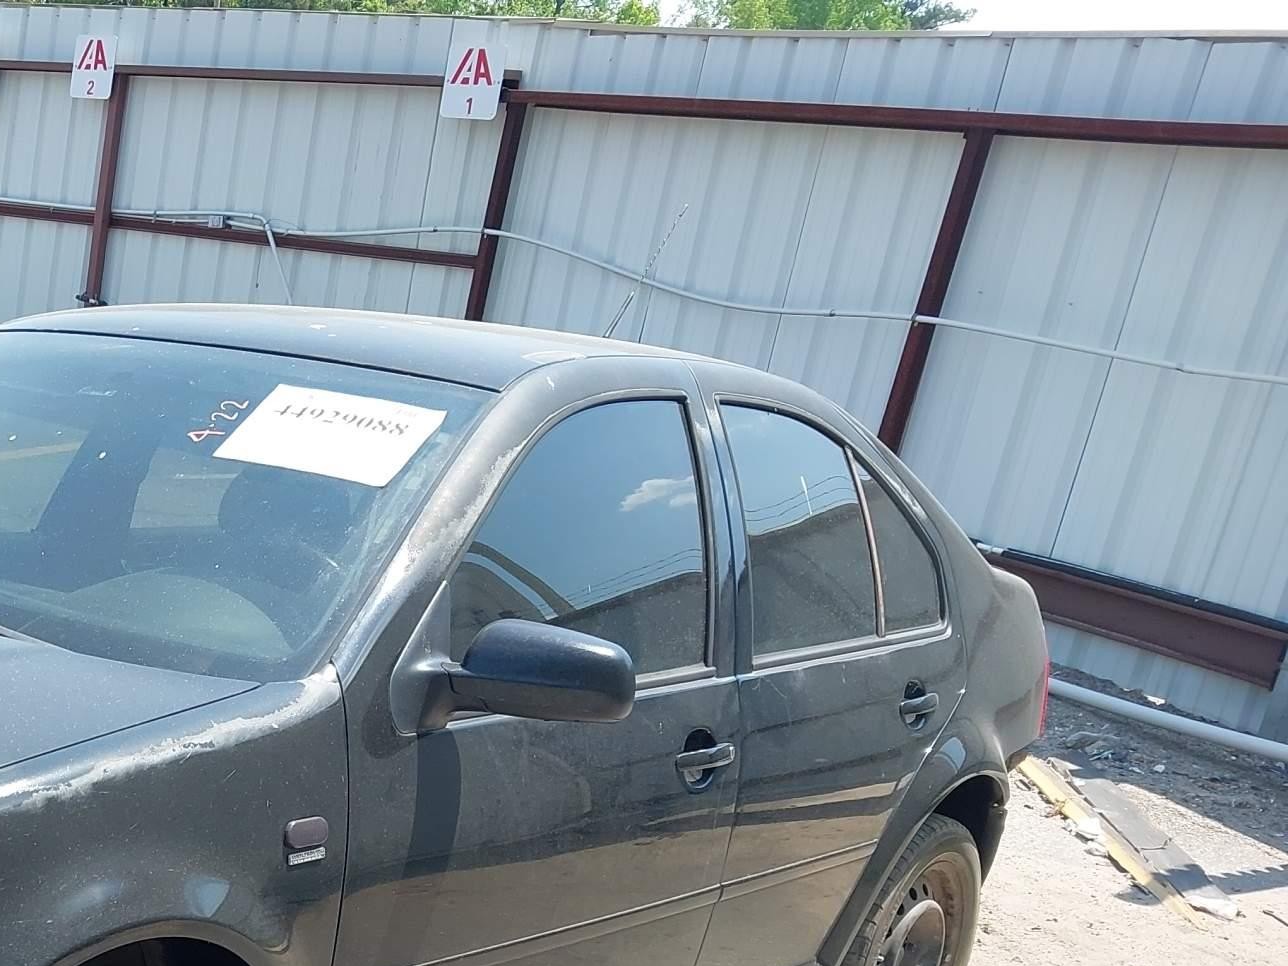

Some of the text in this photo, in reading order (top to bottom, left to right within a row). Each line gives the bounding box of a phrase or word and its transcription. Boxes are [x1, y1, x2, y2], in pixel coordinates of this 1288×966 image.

[86, 80, 95, 95] 2
[465, 97, 474, 115] 1
[275, 404, 409, 436] 44929088
